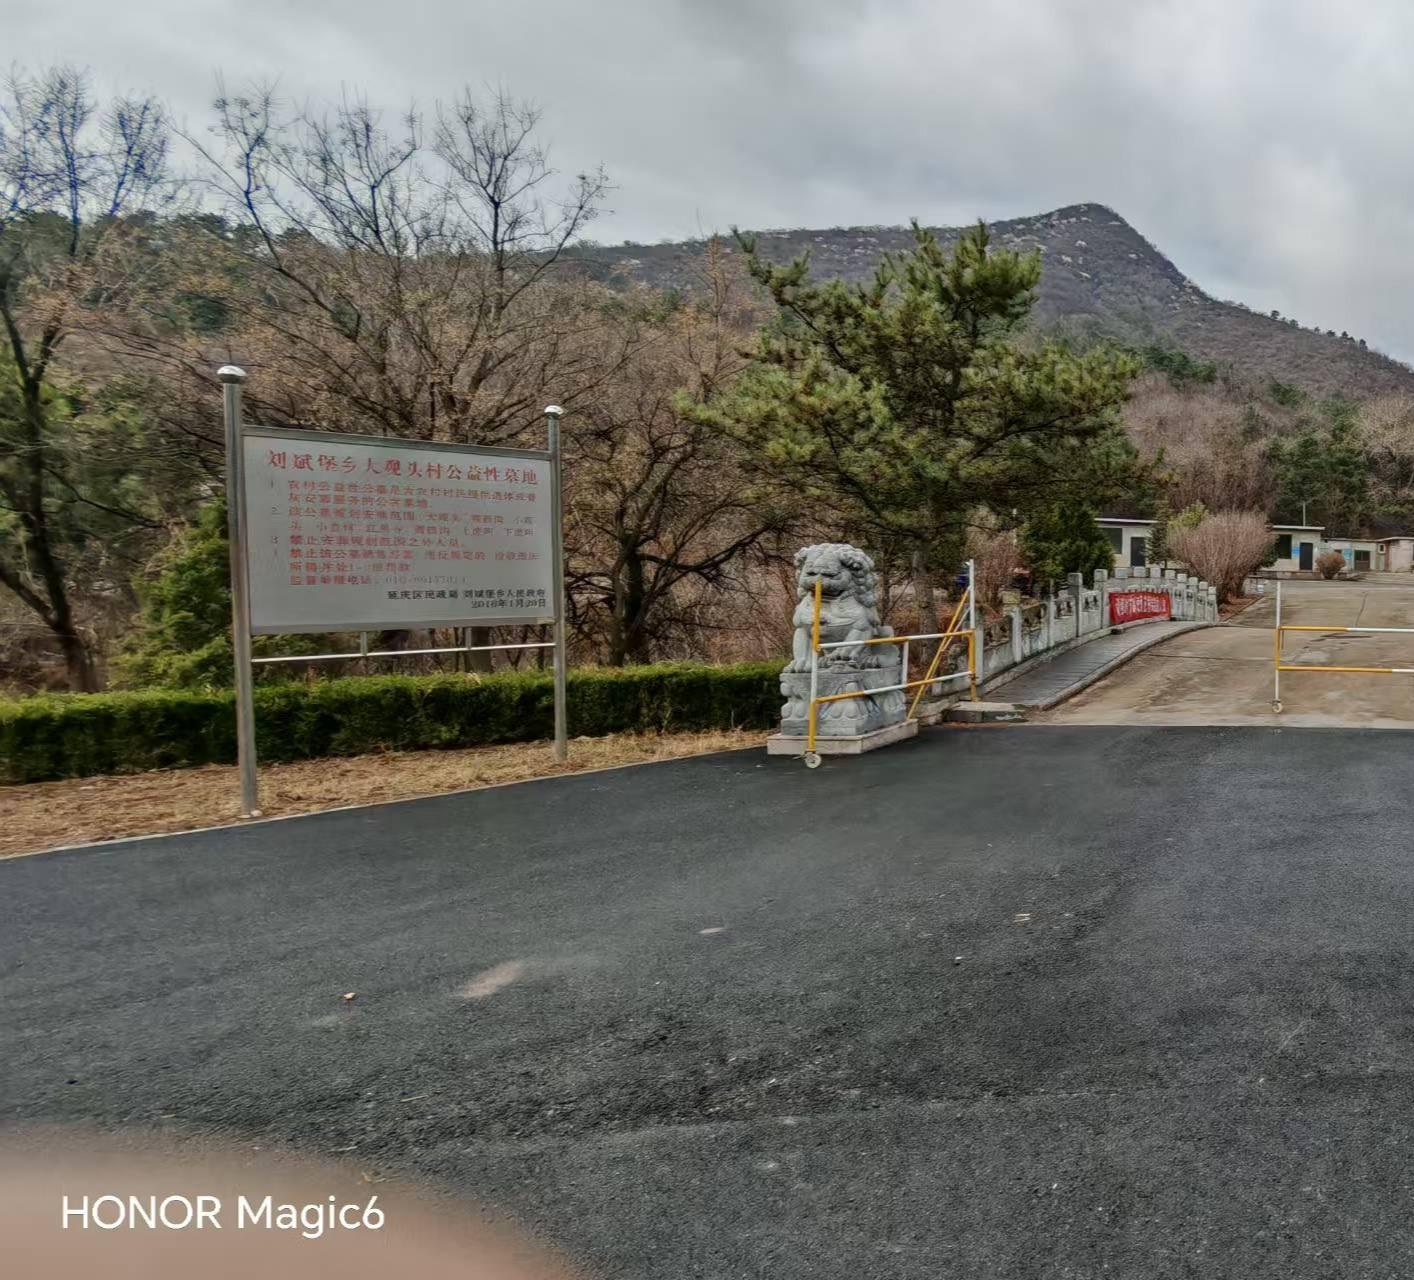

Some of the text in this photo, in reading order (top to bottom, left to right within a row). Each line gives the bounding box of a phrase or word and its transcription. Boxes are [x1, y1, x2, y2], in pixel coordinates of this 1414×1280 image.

[268, 450, 538, 485] 刘斌堡乡大观头村公益性墓地
